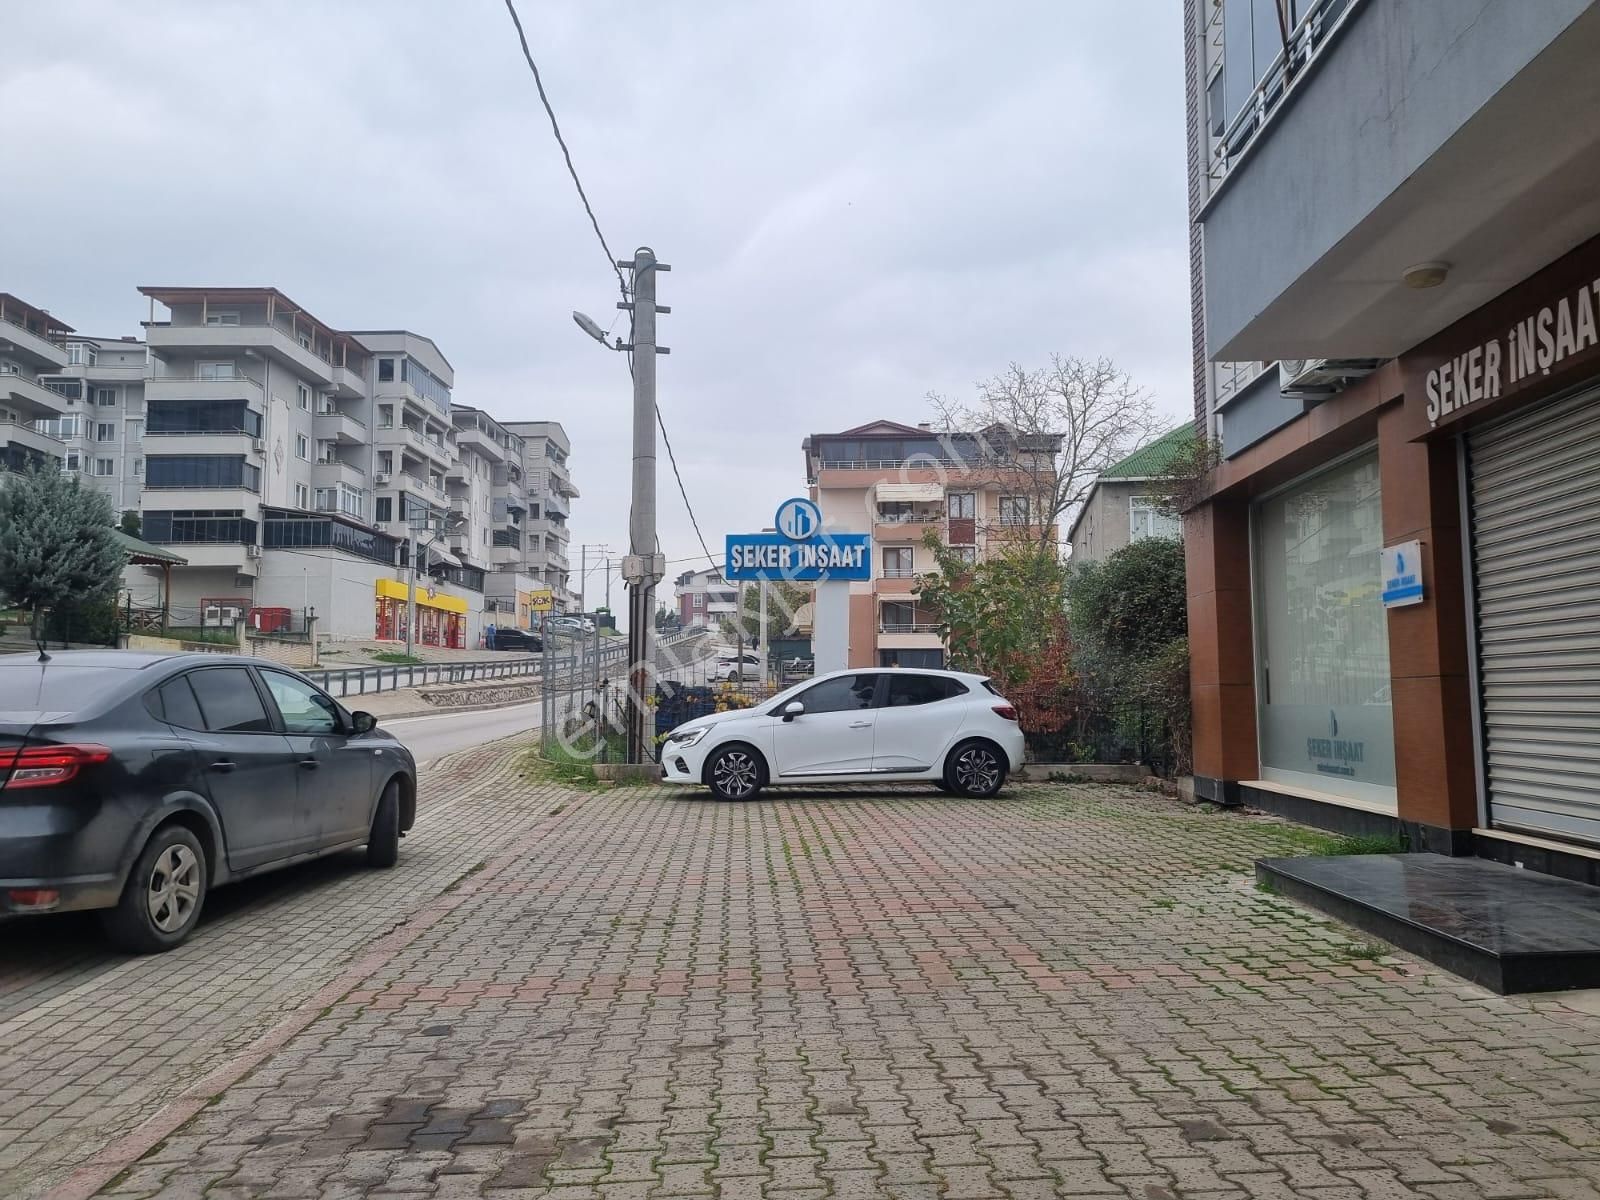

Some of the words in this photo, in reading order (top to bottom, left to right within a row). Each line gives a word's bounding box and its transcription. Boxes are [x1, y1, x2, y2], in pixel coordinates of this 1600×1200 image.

[1426, 339, 1501, 428] ŞEKER
[731, 544, 791, 573] ŞEKER
[799, 544, 865, 573] İNŞAAT
